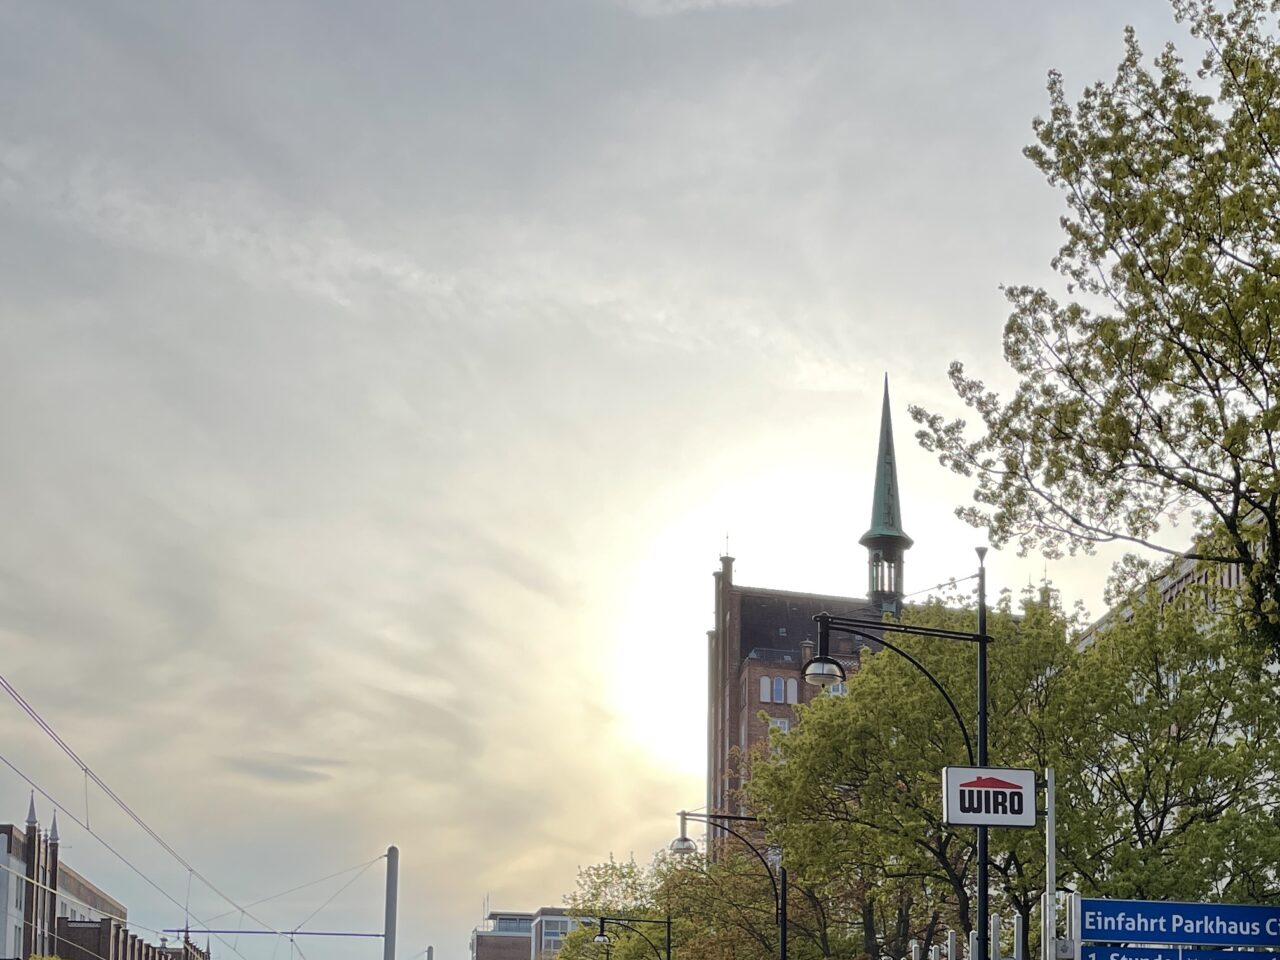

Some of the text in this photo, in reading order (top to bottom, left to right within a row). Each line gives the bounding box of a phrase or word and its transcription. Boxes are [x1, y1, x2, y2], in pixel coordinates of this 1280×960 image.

[959, 789, 1023, 815] WIRO
[1085, 911, 1167, 932] Einfahrt
[1172, 914, 1260, 936] Parkhaus
